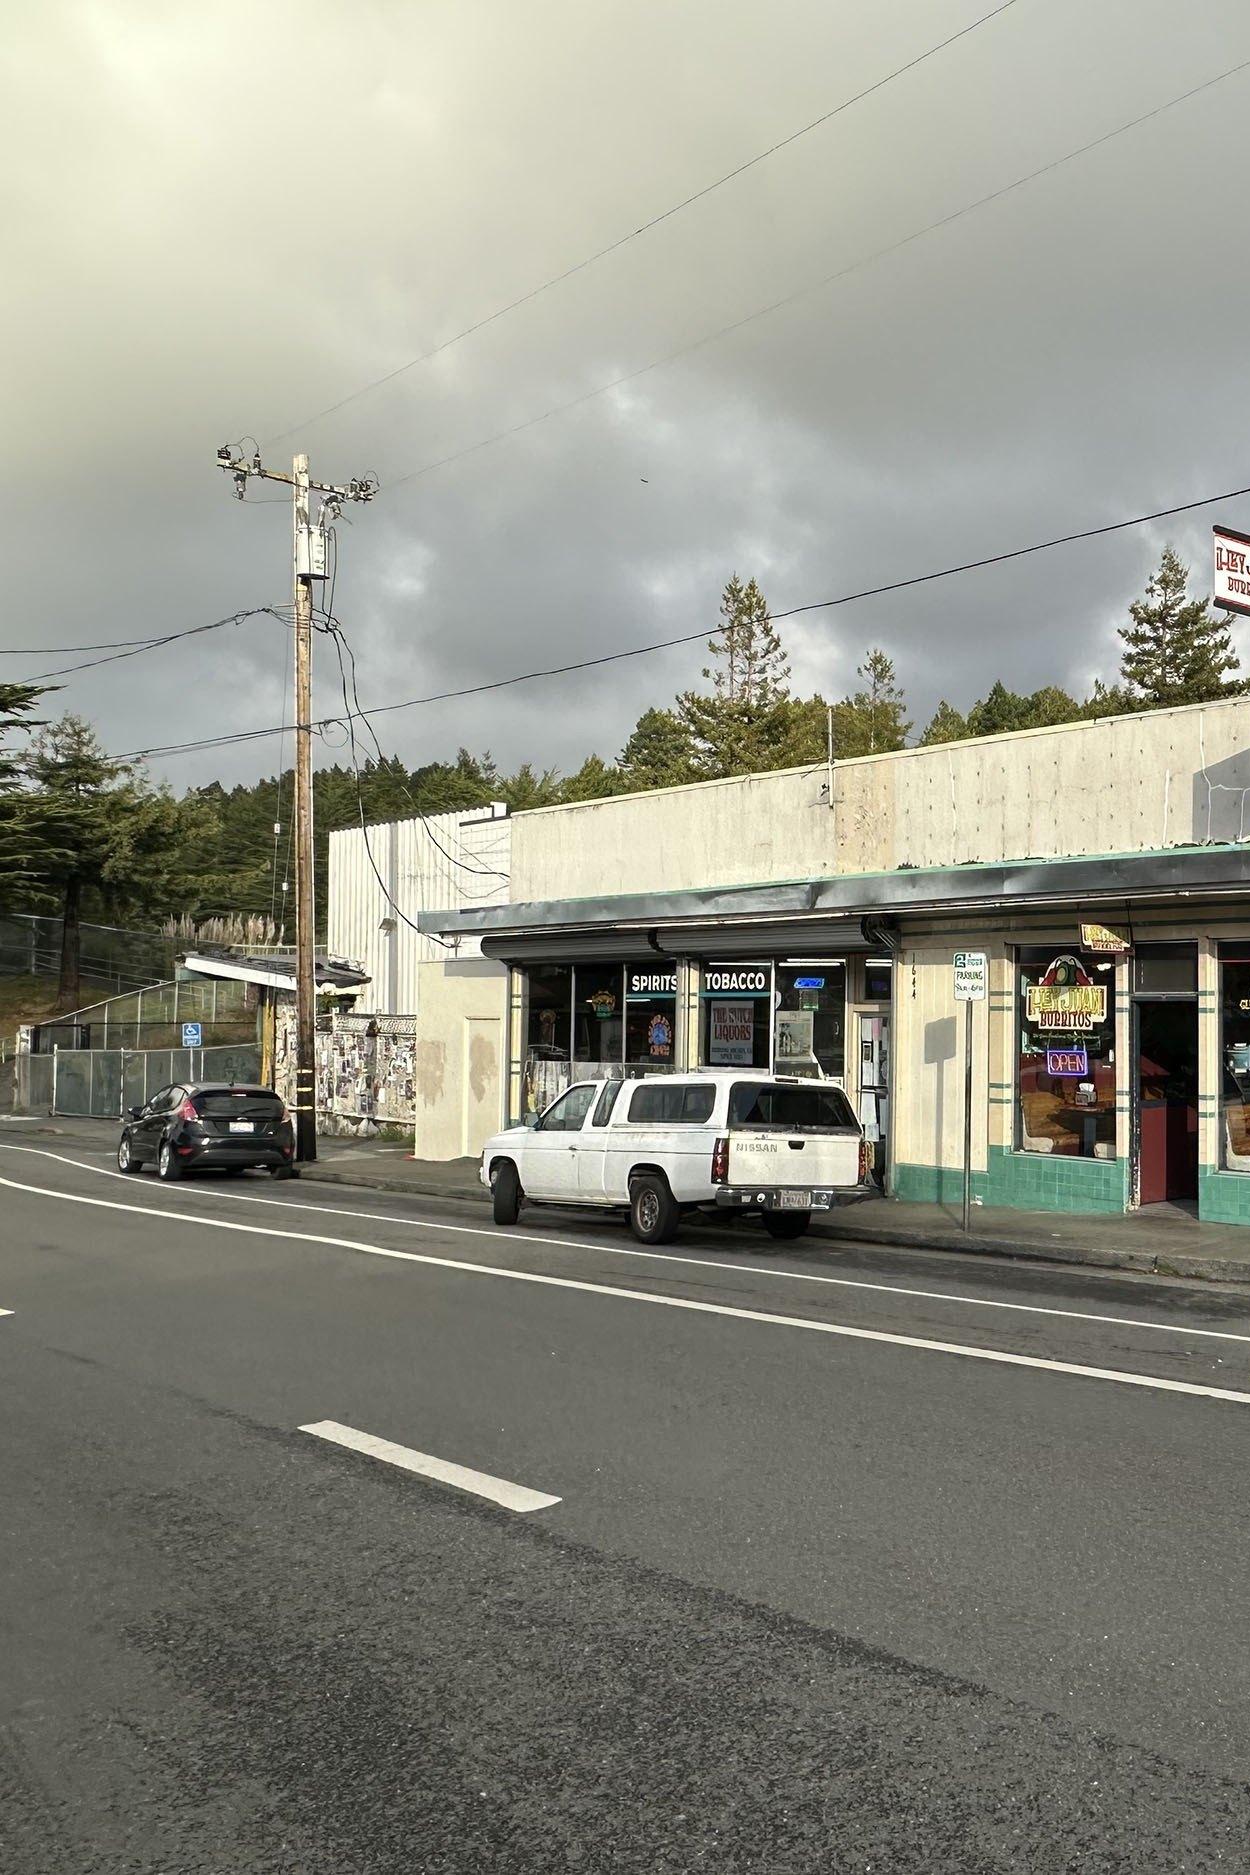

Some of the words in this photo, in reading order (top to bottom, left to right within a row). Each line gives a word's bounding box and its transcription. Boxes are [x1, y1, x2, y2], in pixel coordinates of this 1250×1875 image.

[632, 974, 677, 991] SPIRITS
[705, 972, 766, 990] TOBACCO
[1039, 1011, 1092, 1027] BURRITOS
[714, 1024, 752, 1042] LIQUORS
[1049, 1053, 1085, 1072] OPEN
[736, 1142, 778, 1153] NISSAN
